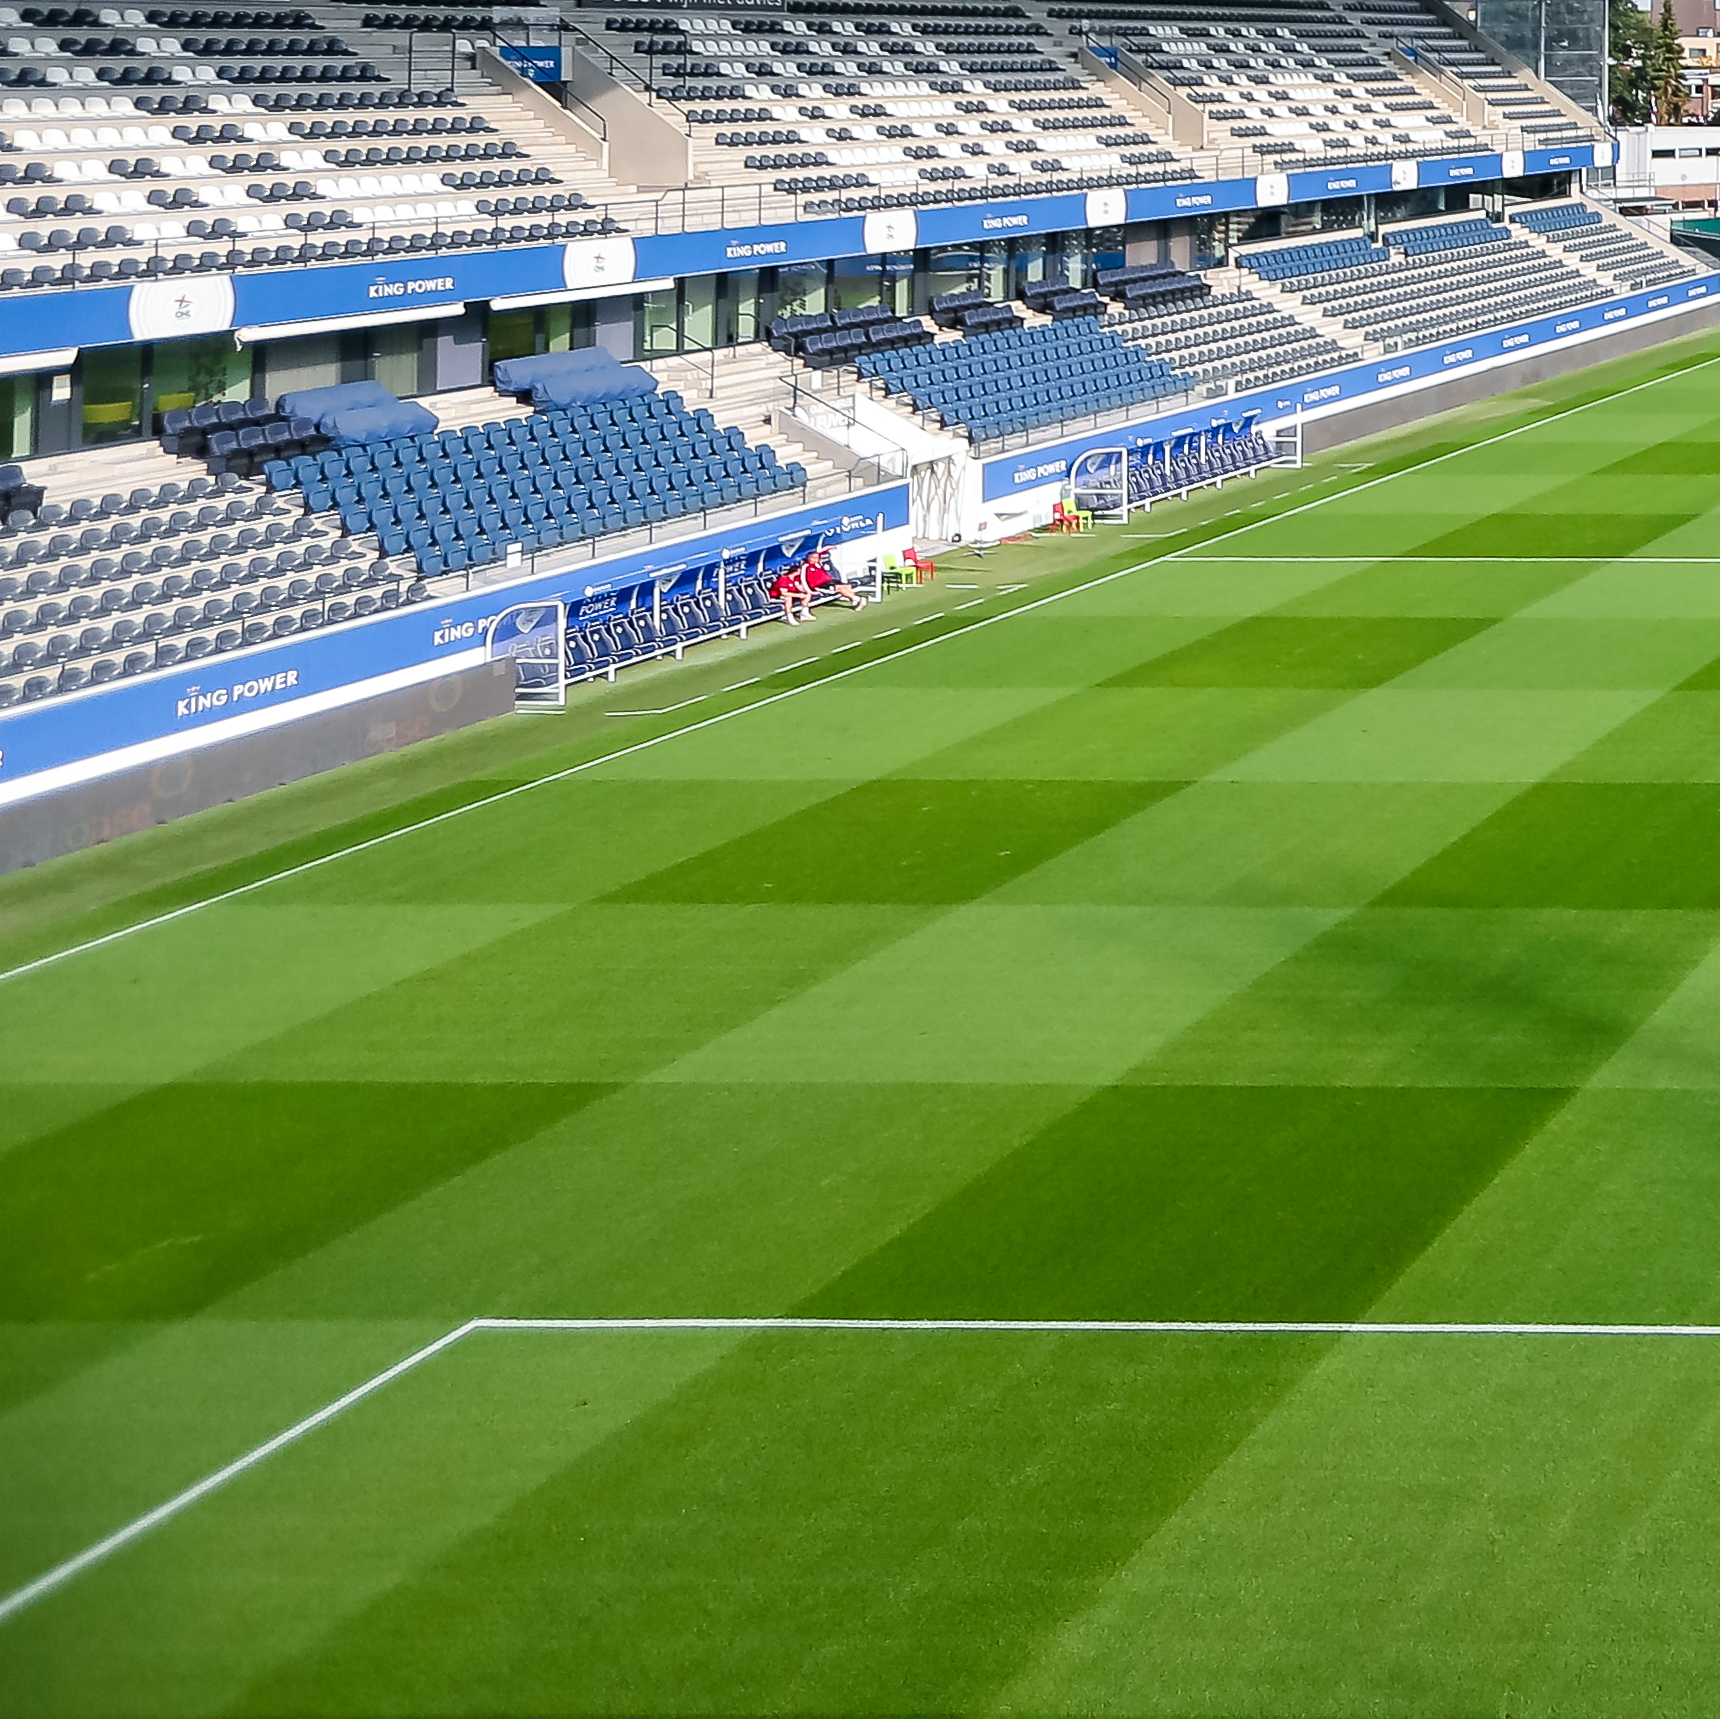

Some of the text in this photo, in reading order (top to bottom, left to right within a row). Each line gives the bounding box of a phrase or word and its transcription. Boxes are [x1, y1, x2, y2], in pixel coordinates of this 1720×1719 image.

[726, 241, 787, 259] KING POWER
[368, 277, 455, 299] KING POWER
[580, 597, 616, 616] POWER
[433, 621, 474, 646] KING
[176, 670, 299, 717] KING POWER
